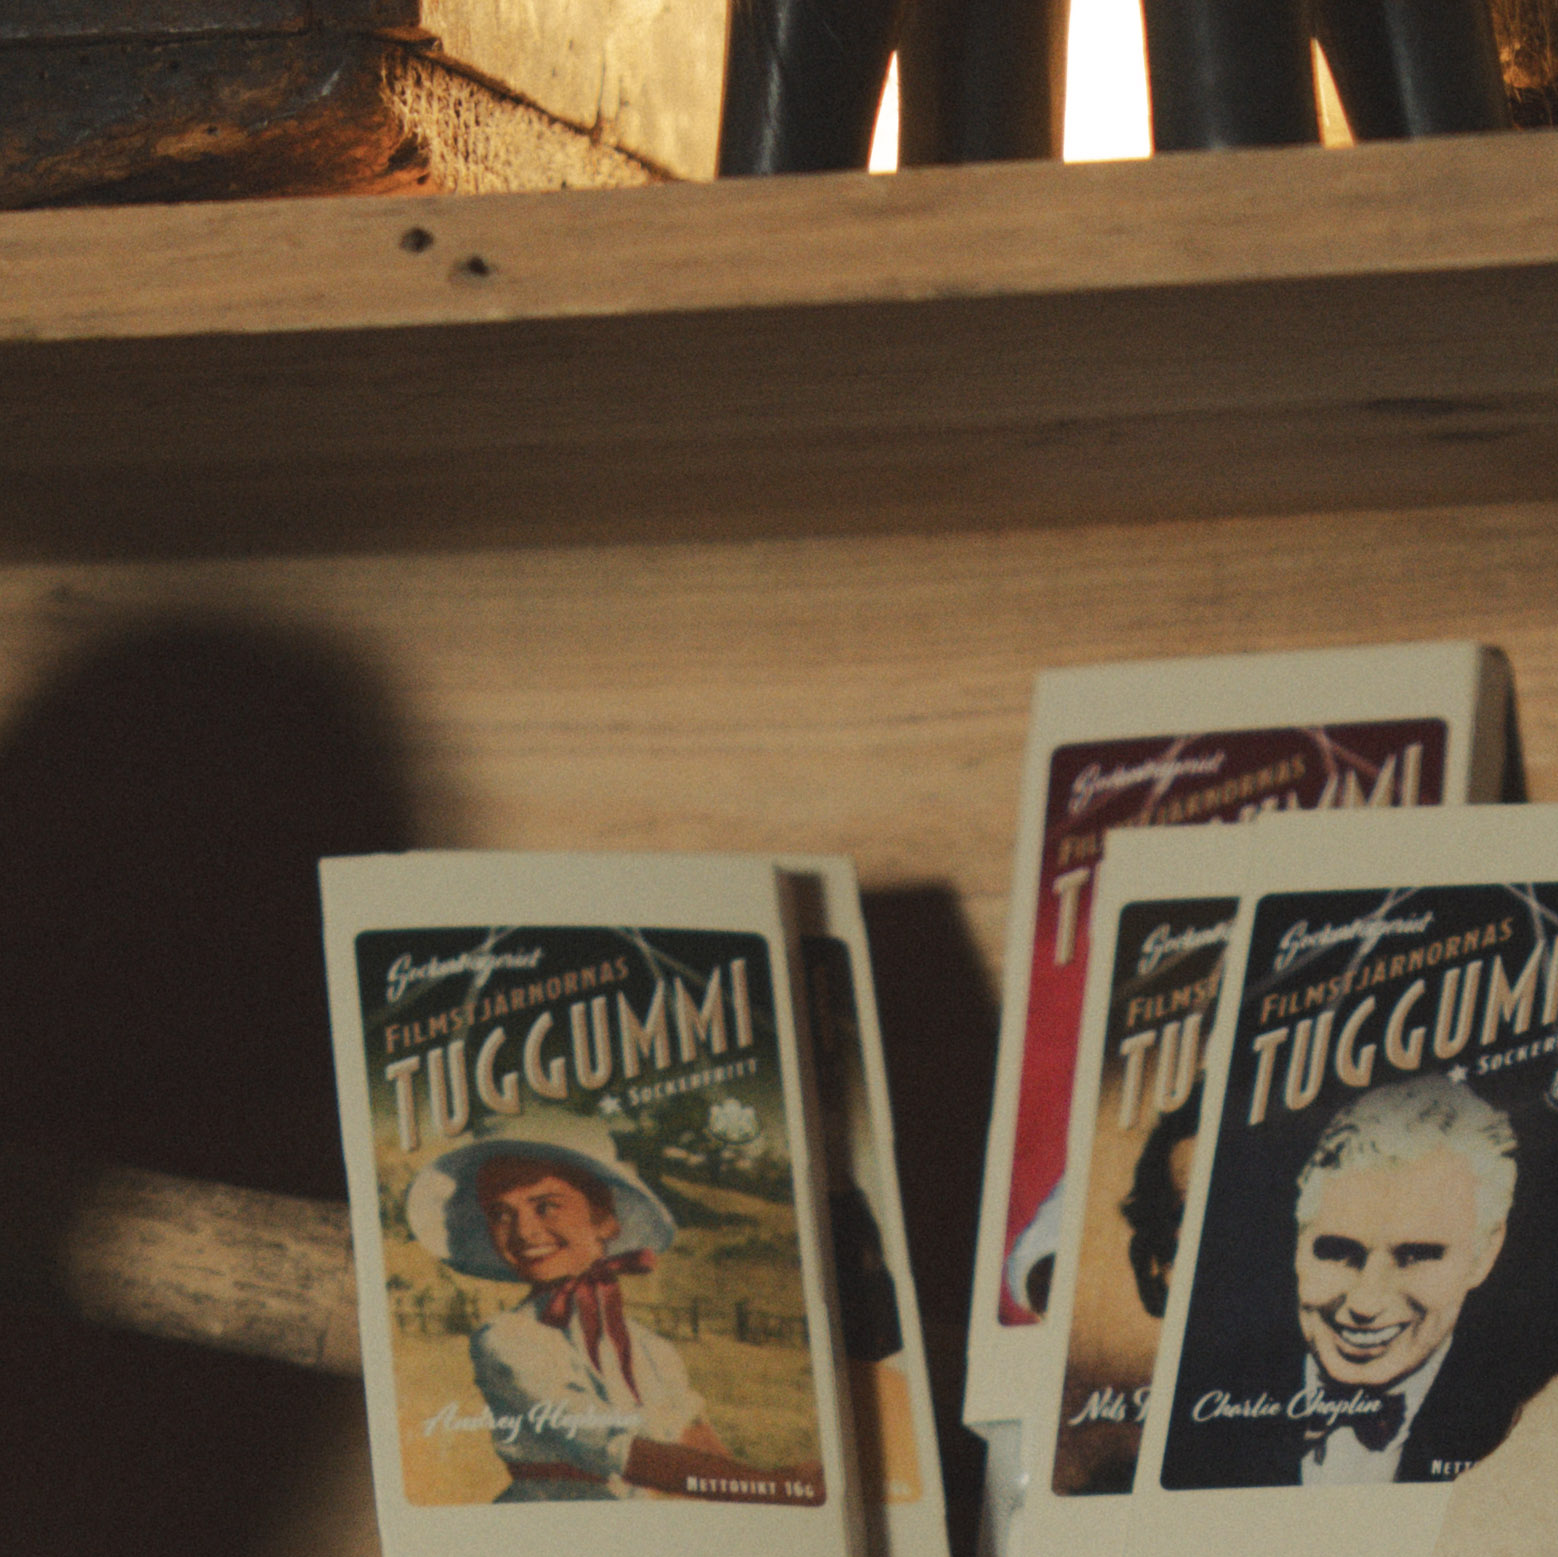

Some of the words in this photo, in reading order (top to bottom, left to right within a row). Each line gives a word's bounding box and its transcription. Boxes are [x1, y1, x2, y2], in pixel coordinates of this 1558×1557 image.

[384, 957, 754, 1154] TUGGUMMI
[1192, 1389, 1281, 1423] Charlie
[1286, 1388, 1383, 1426] Chaplin
